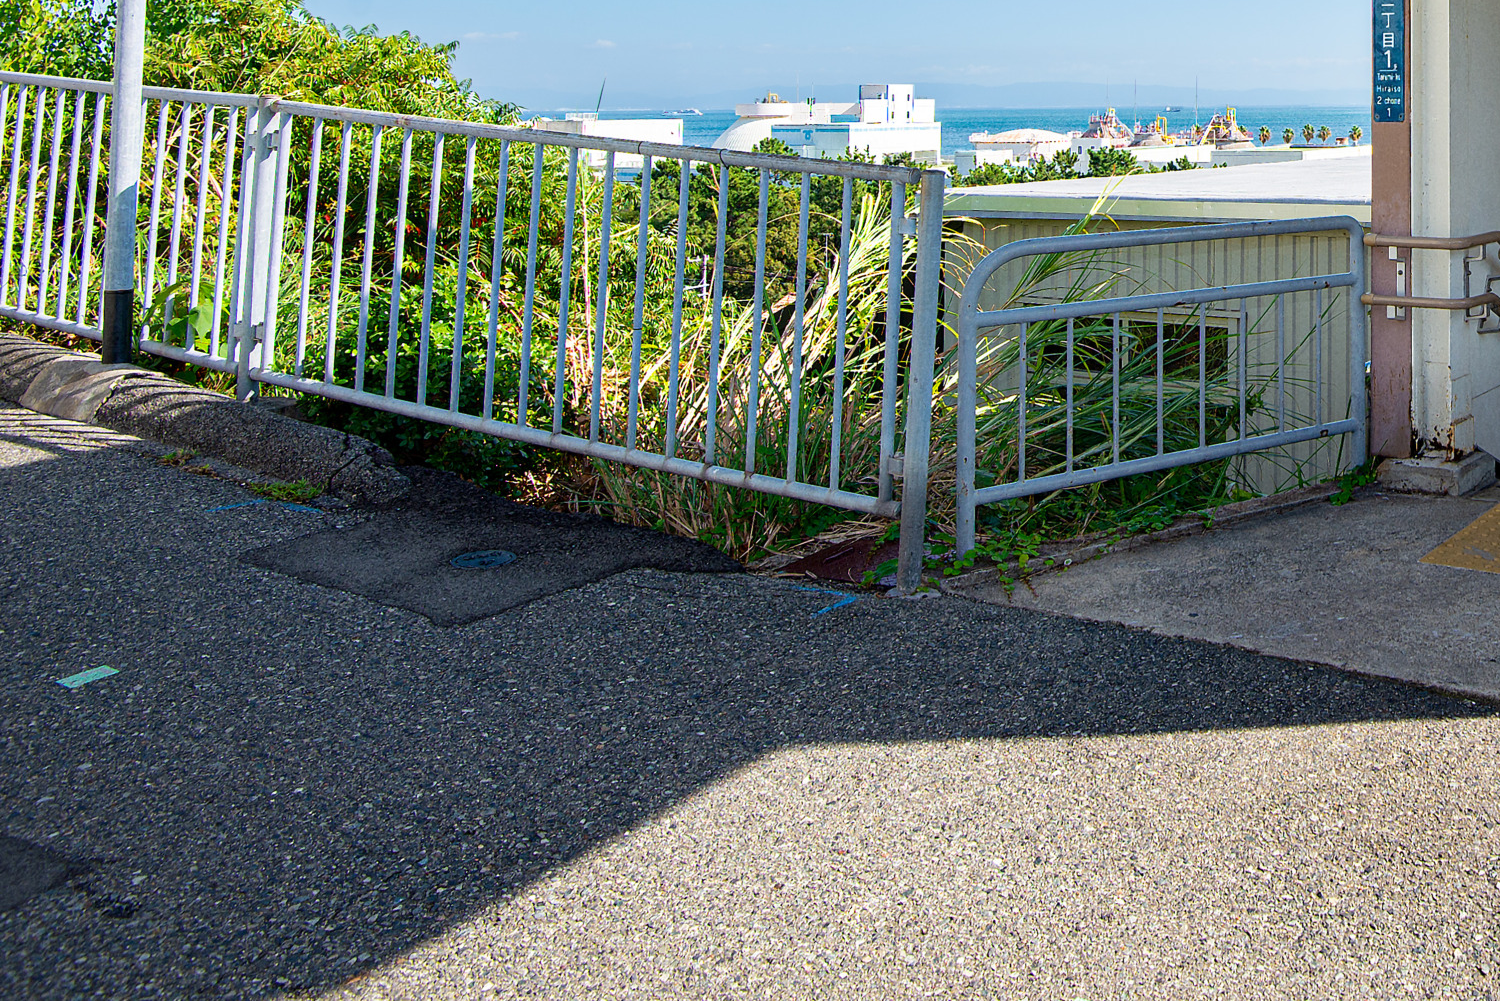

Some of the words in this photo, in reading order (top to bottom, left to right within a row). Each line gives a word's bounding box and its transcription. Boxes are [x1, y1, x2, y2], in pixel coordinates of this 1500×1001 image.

[1376, 85, 1401, 93] Hiraiso
[1377, 96, 1382, 105] 2
[1387, 107, 1391, 117] 1
